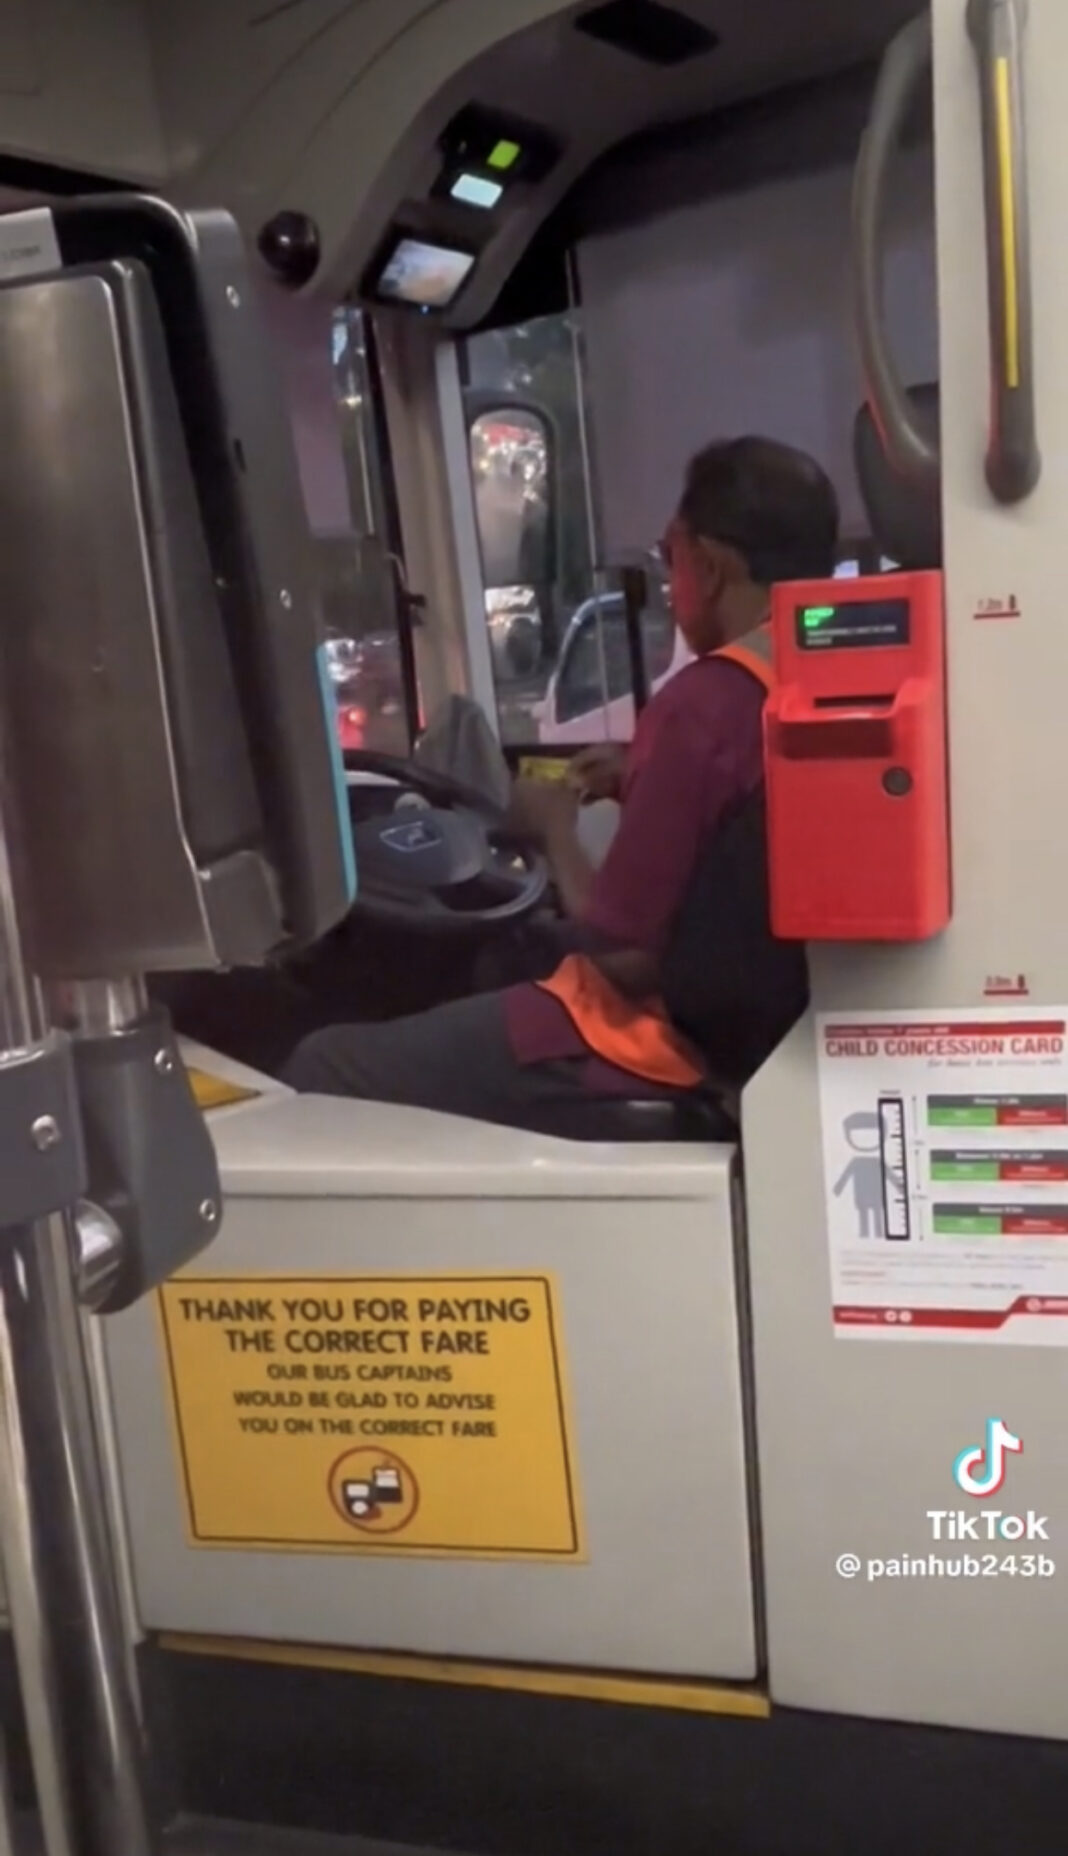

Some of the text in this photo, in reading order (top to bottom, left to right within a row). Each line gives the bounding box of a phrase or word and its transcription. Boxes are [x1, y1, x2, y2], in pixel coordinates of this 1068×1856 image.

[826, 1036, 1063, 1057] CHILD CONCESSION CARD
[179, 1298, 531, 1323] THANK YOU FOR PAYING
[225, 1330, 490, 1355] THE CORRECT FARE
[267, 1364, 453, 1382] OUR BUS CAPTAINS
[233, 1391, 496, 1410] WOULD BE GLAD TO ADVISE
[239, 1418, 497, 1437] YOU ON THE CORRECT FARE
